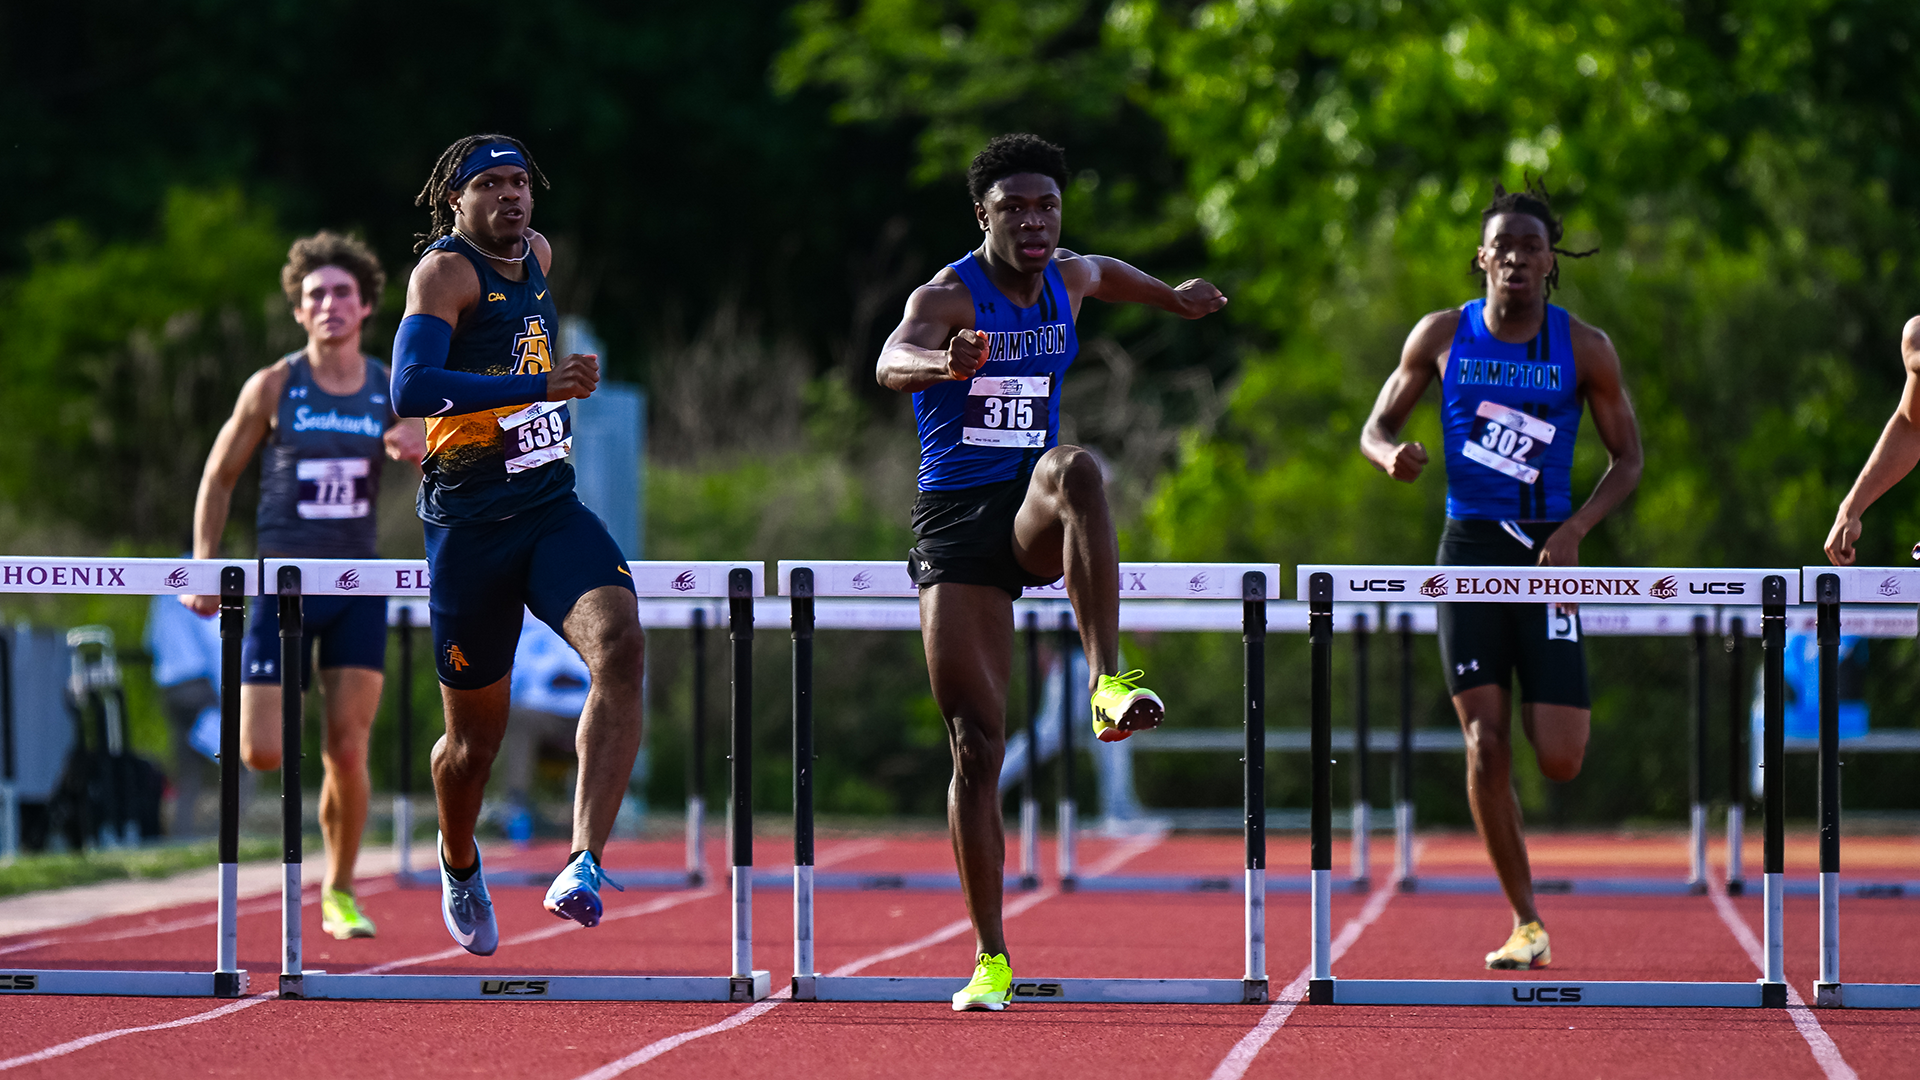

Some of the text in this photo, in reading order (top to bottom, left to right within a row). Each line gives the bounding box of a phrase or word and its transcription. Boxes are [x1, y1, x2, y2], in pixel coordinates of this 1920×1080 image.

[488, 292, 506, 302] CAA
[1458, 358, 1562, 391] HAMPTON
[984, 397, 1033, 429] 315
[293, 405, 381, 437] Seahawks
[518, 411, 564, 453] 539
[1481, 422, 1534, 462] 302
[2, 566, 126, 587] HOENIX
[165, 578, 189, 586] ELON
[336, 580, 359, 588] ELON
[395, 570, 430, 589] EL
[672, 581, 695, 589] ELON
[1350, 579, 1406, 592] UCS
[1455, 578, 1641, 596] ELON PHOENIX
[1651, 588, 1677, 597] ELON
[1689, 582, 1745, 595] UCS
[1556, 607, 1571, 637] 5
[0, 974, 36, 989] CS
[482, 981, 548, 994] UCS
[1011, 983, 1060, 997] CS
[1512, 987, 1583, 1002] UCS
